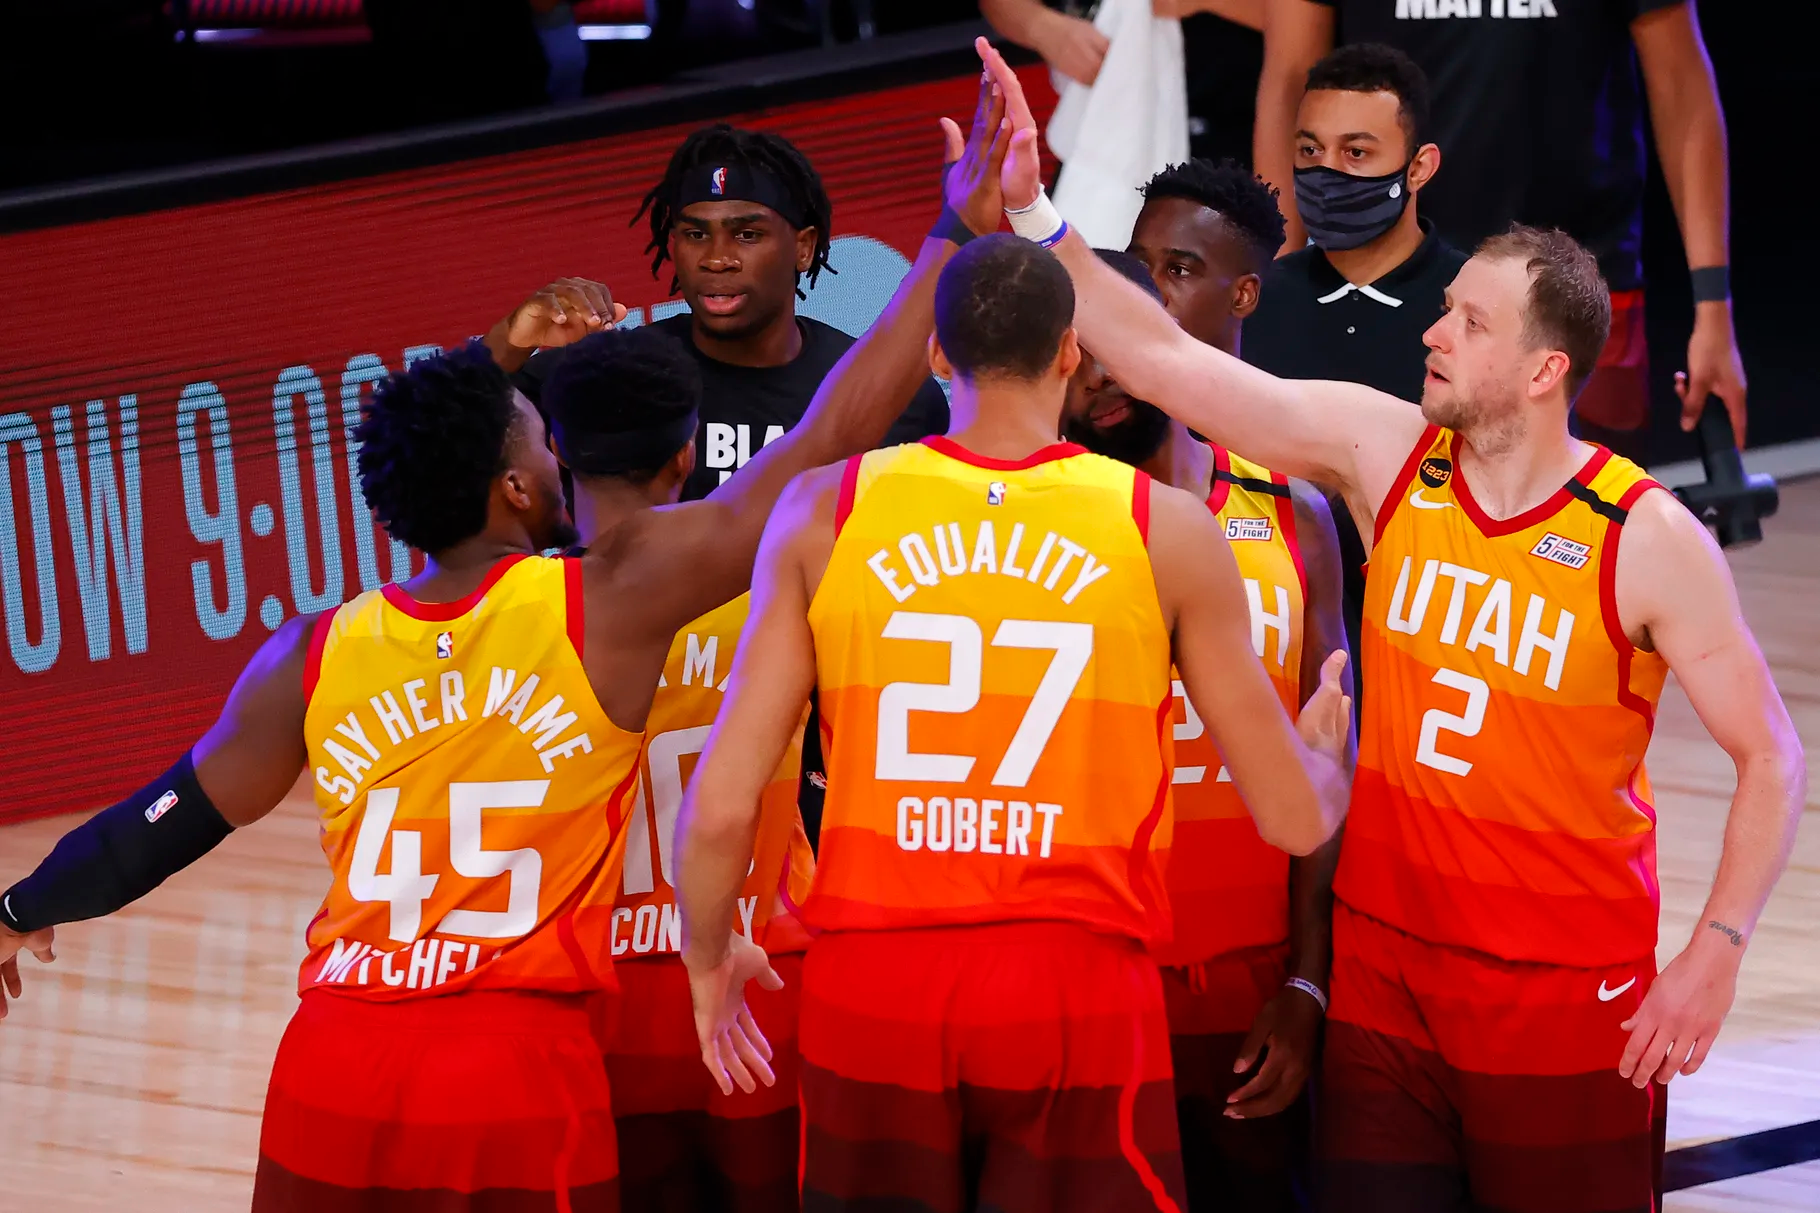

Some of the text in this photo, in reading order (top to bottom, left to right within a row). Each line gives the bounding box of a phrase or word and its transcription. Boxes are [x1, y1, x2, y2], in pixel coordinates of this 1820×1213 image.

[1422, 461, 1450, 481] 1223
[1228, 520, 1239, 537] 5
[1242, 529, 1269, 538] FIGHT
[1536, 536, 1586, 554] 5 FOR THE
[1551, 550, 1584, 566] FIGHT
[866, 520, 1111, 605] EQUALITY
[1386, 555, 1576, 692] UTAH
[875, 611, 1094, 788] 27
[1415, 667, 1490, 777] 2
[316, 666, 593, 805] SAY HER NAME
[896, 796, 1064, 859] GOBERT
[347, 779, 551, 944] 45
[611, 896, 758, 956] CONY
[314, 937, 502, 990] MITCHEL
